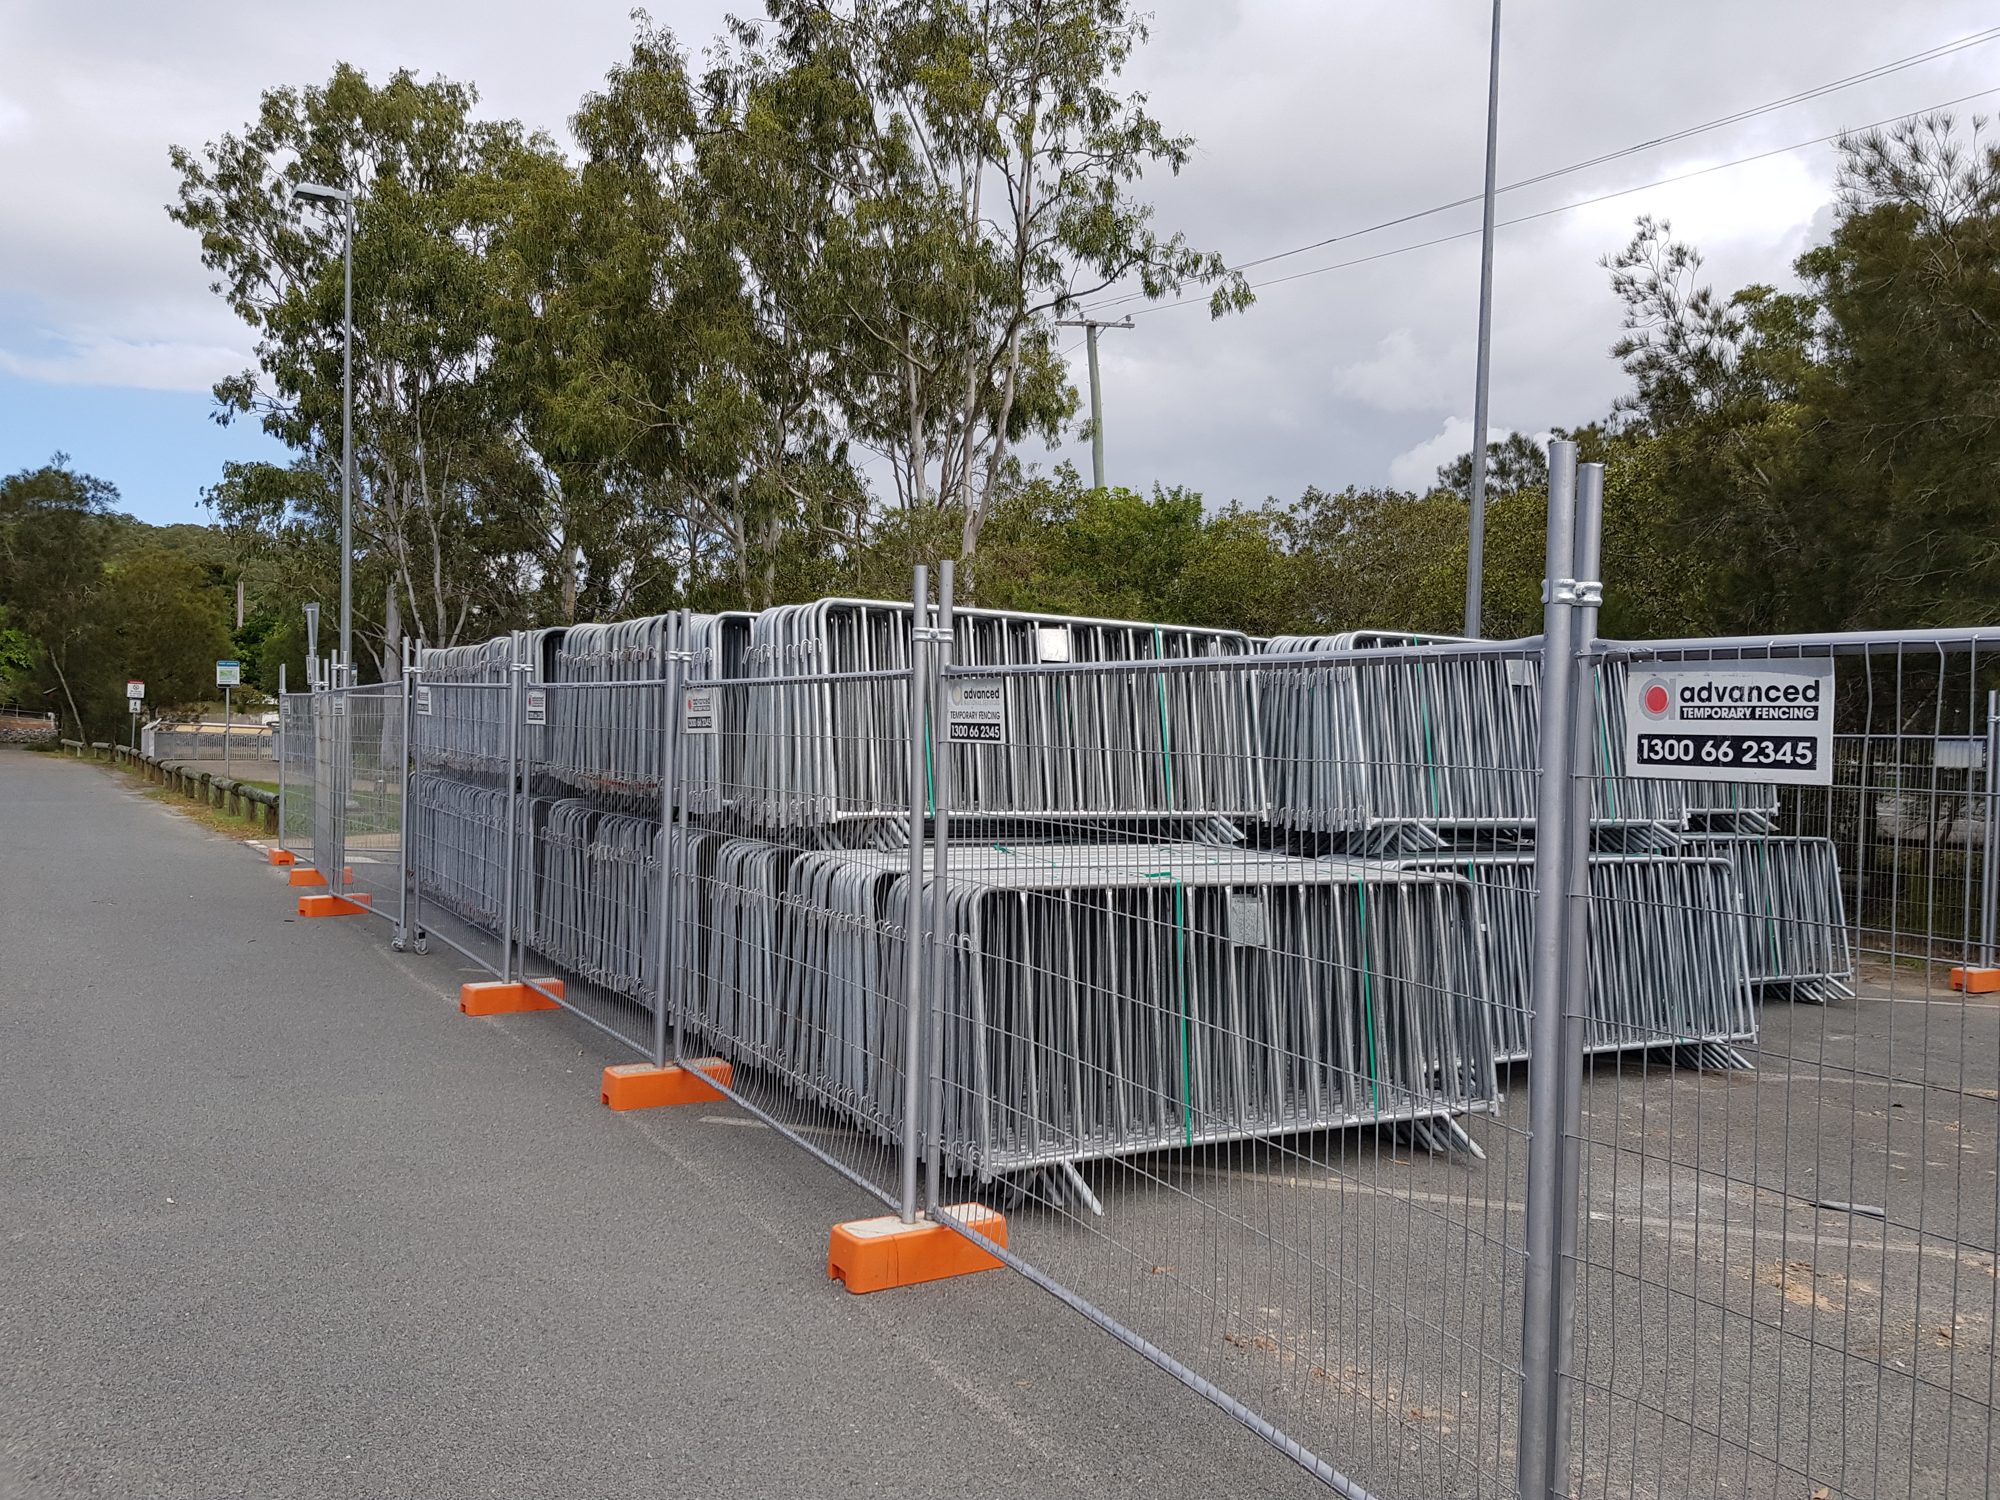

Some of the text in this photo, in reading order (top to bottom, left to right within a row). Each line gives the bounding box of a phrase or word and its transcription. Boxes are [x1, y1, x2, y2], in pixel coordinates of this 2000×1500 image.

[964, 688, 1000, 700] advanced
[1679, 680, 1820, 703] advanced
[950, 711, 1000, 720] TEMPORARY FENCING
[1682, 707, 1815, 720] TEMPORARY FENCING
[952, 724, 1000, 738] 1300 66 2345
[1640, 738, 1813, 765] 1300 66 2345
